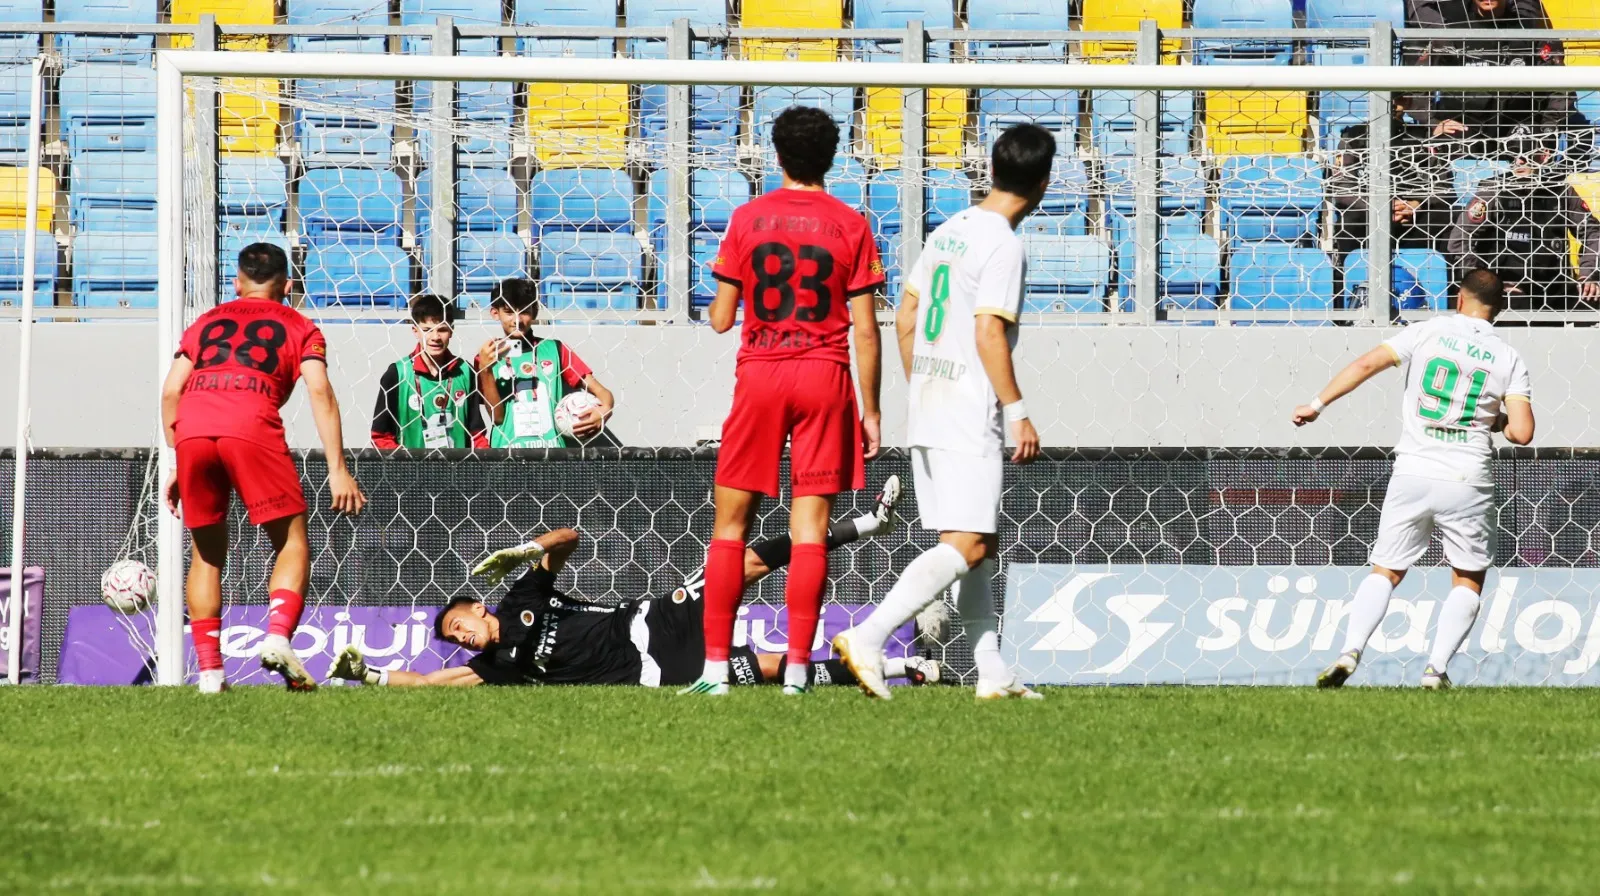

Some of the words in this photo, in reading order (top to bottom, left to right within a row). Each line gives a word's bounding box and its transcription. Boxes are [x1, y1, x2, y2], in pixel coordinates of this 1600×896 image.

[751, 241, 834, 323] 83
[923, 261, 951, 345] 8
[194, 318, 288, 375] 88
[1466, 343, 1496, 364] YAPI
[186, 374, 273, 399] IRATCAN
[1416, 356, 1490, 428] 91
